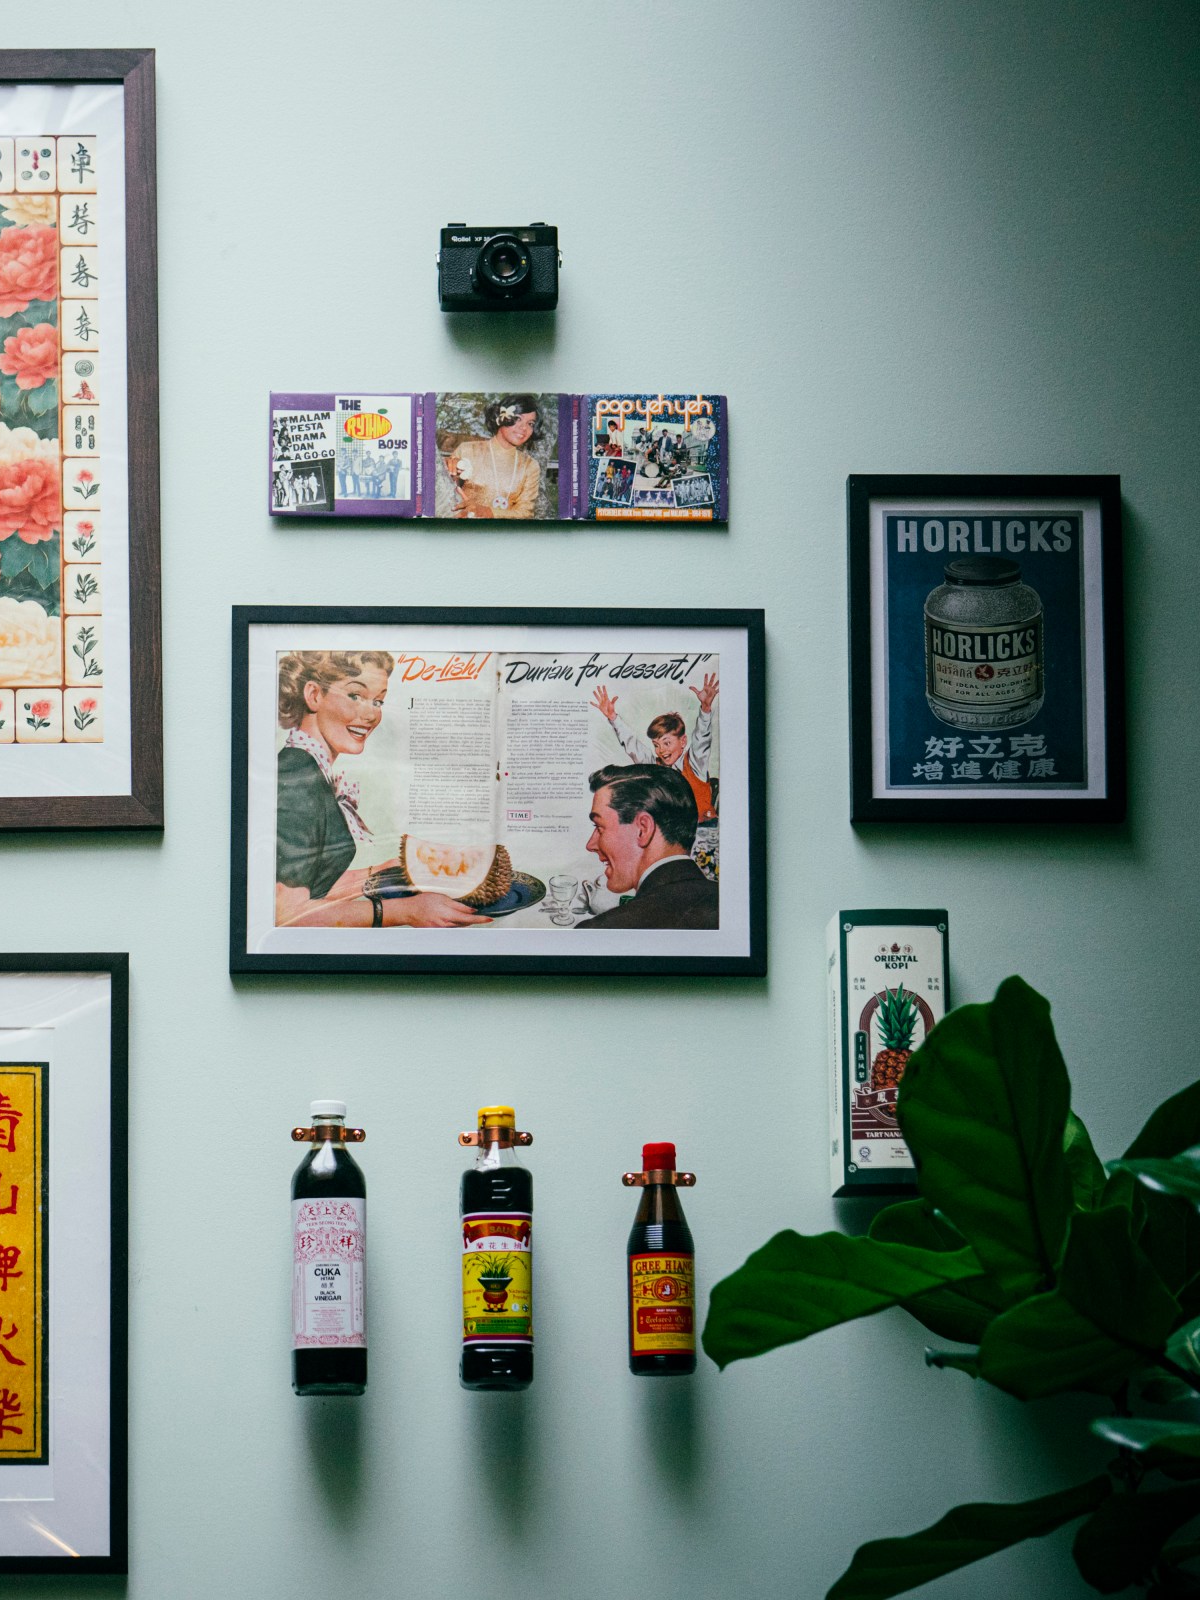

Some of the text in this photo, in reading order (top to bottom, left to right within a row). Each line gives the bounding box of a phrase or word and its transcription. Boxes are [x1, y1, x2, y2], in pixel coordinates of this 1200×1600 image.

[339, 399, 361, 411] THE
[289, 412, 331, 424] MALAM
[596, 399, 635, 431] pop
[635, 394, 674, 431] yeh
[674, 394, 713, 432] yeh
[290, 422, 323, 432] PESTA
[291, 432, 327, 442] IRAMA
[293, 442, 315, 452] DAN
[378, 439, 408, 450] BOYS
[897, 520, 1072, 552] HORLICKS
[932, 628, 1035, 660] HORLICKS
[505, 659, 573, 684] Durian
[575, 654, 610, 687] for
[924, 734, 1048, 759] 好立克
[912, 758, 1058, 781] 增進健康
[314, 1267, 341, 1277] CUKA
